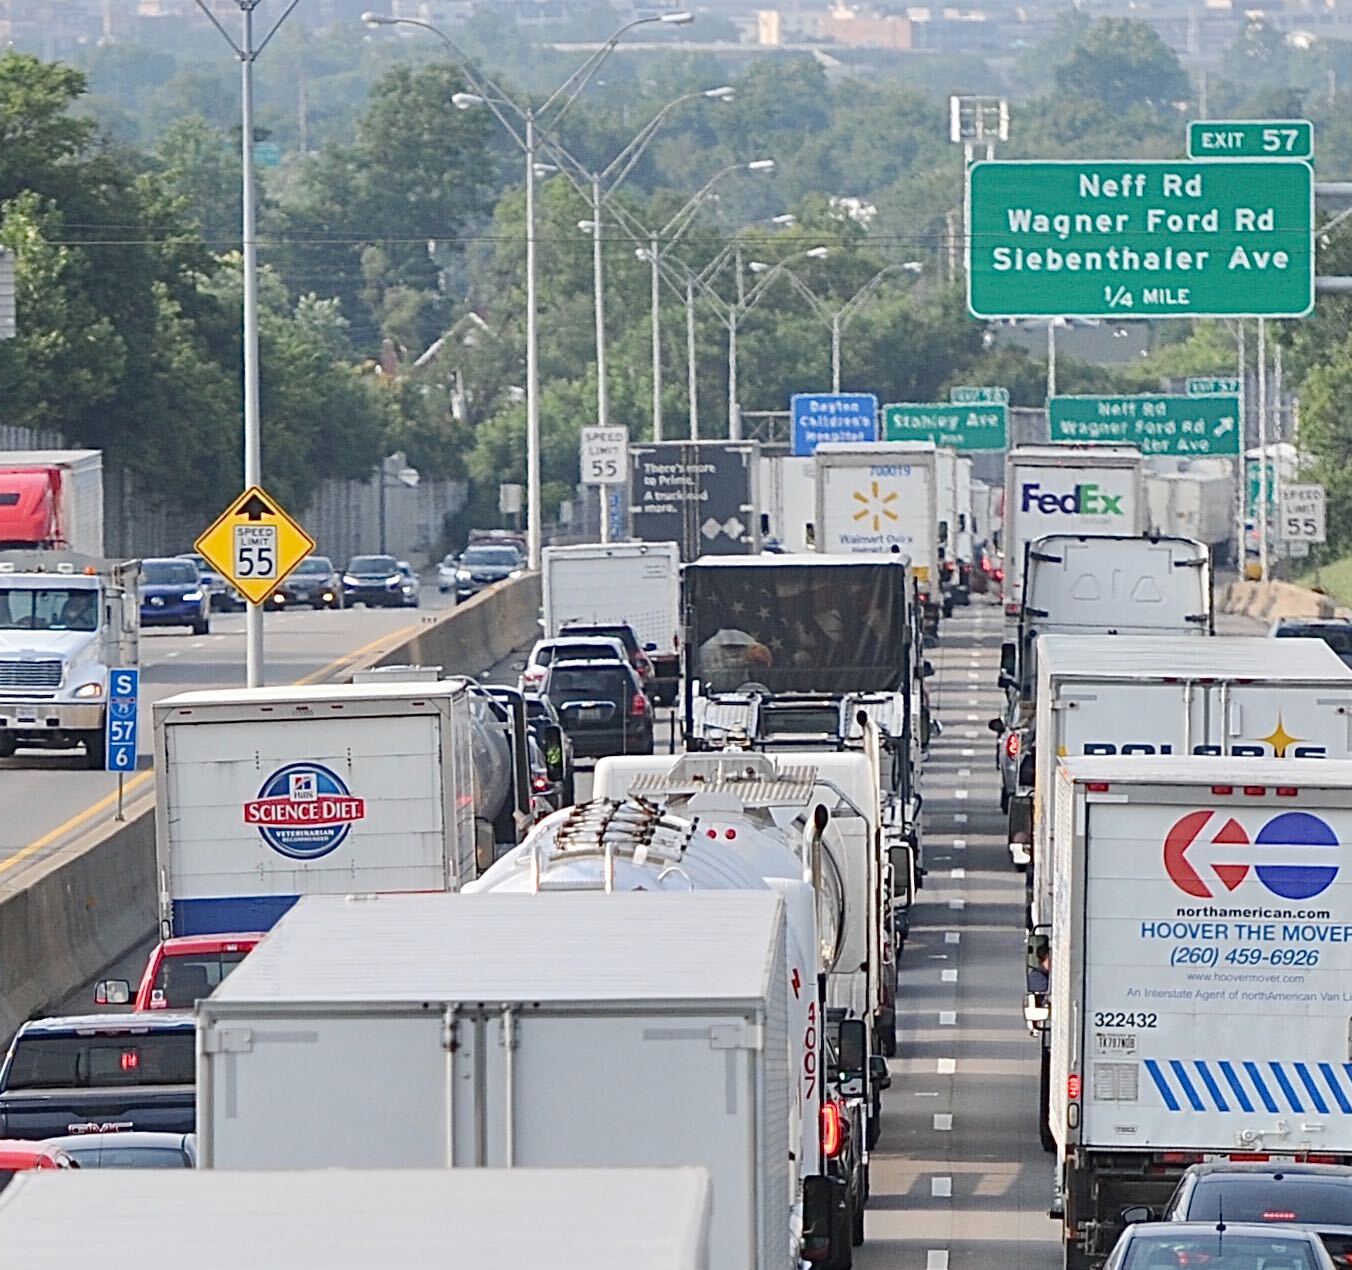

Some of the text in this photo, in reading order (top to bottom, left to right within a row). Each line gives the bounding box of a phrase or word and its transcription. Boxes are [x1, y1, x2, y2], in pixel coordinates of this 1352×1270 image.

[1201, 129, 1300, 152] EXIT 57
[1079, 174, 1202, 198] Neff Rd
[1007, 210, 1275, 240] Wagner Ford Rd
[992, 248, 1289, 271] Siebenthaler Ave
[1143, 289, 1190, 306] MILE
[809, 400, 860, 414] Dayton
[966, 412, 998, 427] Ave
[585, 432, 623, 442] SPEED
[588, 446, 619, 456] LIMIT
[592, 460, 617, 477] 55
[643, 491, 653, 500] A
[1021, 483, 1124, 516] FedEx
[1283, 490, 1322, 499] SPEED
[236, 528, 274, 537] SPEED
[1287, 519, 1317, 536] 55
[240, 537, 269, 546] LIMIT
[237, 547, 274, 576] 55
[116, 675, 132, 694] S
[111, 721, 134, 741] 57
[116, 747, 128, 766] 6
[248, 803, 319, 821] SCIENCE
[1176, 905, 1330, 920] northamerican.com
[1141, 922, 1229, 940] HOOVER
[1235, 924, 1275, 941] THE
[1169, 946, 1319, 968] (260) 459-6926
[1187, 972, 1305, 983] www.hoovermover.com
[1127, 987, 1141, 998] An
[1145, 988, 1192, 999] Interstate
[1196, 989, 1226, 1002] Agent
[1228, 989, 1240, 1000] of
[1320, 991, 1340, 1002] Van
[1094, 1012, 1157, 1028] 322432
